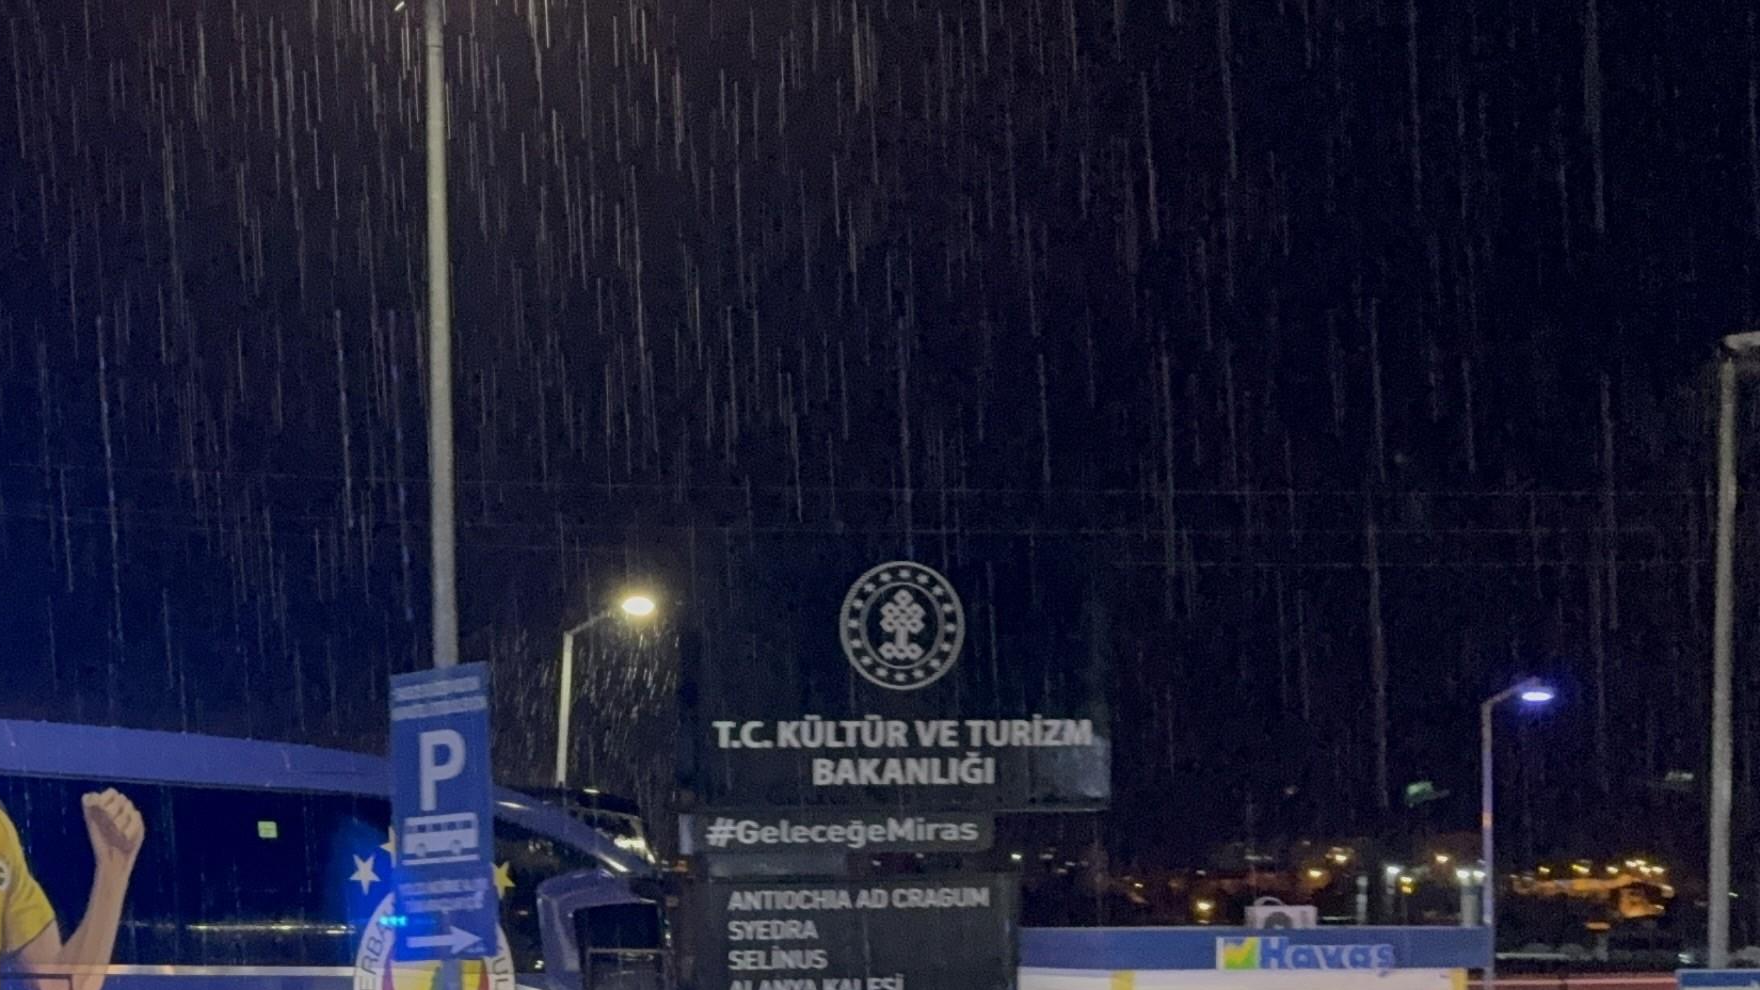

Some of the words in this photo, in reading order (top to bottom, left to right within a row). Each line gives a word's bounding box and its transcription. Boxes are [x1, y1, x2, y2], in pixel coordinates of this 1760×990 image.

[712, 720, 773, 749] T.C.
[777, 714, 909, 748] KÜLTÜR
[914, 718, 960, 748] VE
[964, 713, 1095, 748] TURİZM
[419, 729, 466, 811] P
[812, 751, 996, 786] BAKANLIĞI
[705, 816, 980, 848] #GeleceğeMiras
[726, 888, 852, 911] ANTIOCHIA
[855, 888, 889, 909] AD
[727, 919, 819, 941] SYEDRA
[727, 946, 828, 970] SELİNUS
